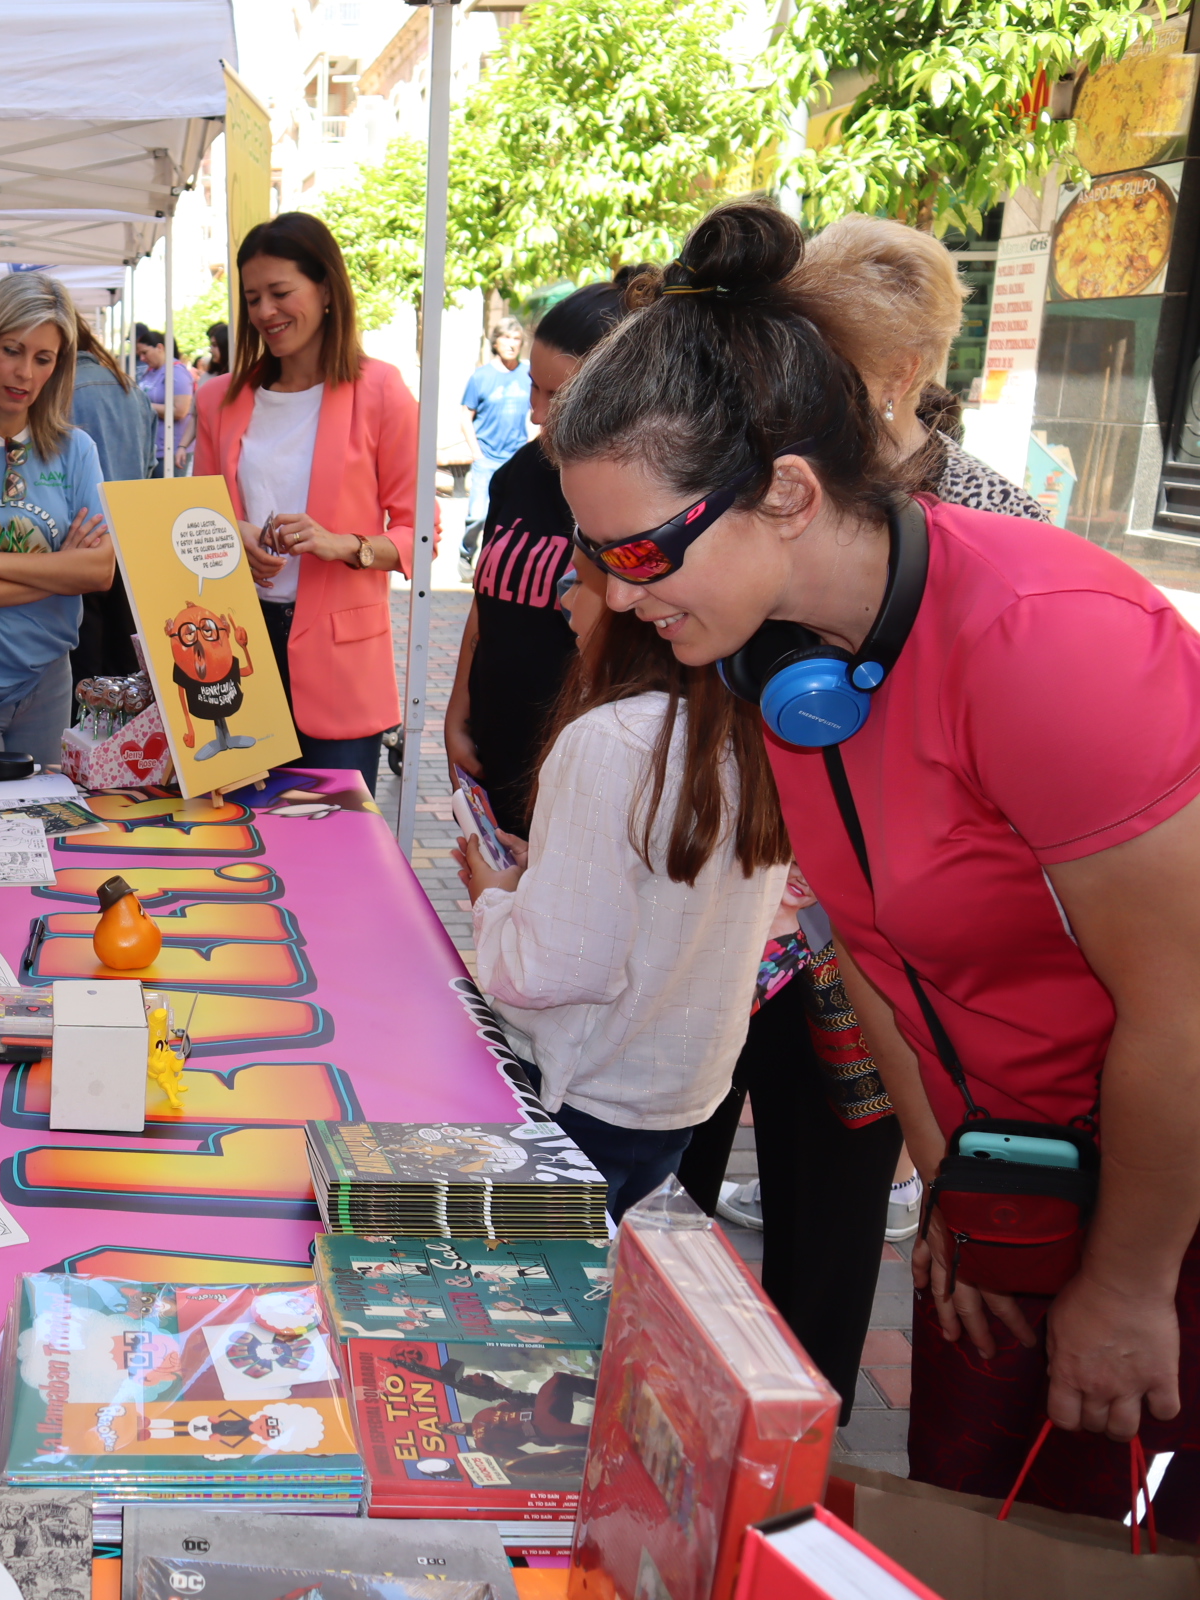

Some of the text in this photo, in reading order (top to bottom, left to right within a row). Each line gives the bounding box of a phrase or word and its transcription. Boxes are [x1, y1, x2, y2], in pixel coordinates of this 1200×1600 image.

[1077, 177, 1157, 204] ASADO DE PULPO
[1030, 238, 1049, 251] Gris
[10, 501, 59, 538] LECTURA
[473, 518, 576, 611] ÁLID
[798, 709, 820, 722] ENERGY
[123, 750, 143, 760] Jelly
[138, 759, 157, 769] Rose
[332, 1266, 371, 1312] TIEMPOS
[368, 1283, 390, 1295] de
[425, 1243, 498, 1336] HARINA & Sal
[42, 1292, 72, 1357] Trinidad
[358, 1352, 380, 1404] SOLIDARIO!
[36, 1360, 71, 1434] llamaban
[365, 1406, 385, 1444] ESPECIAL
[379, 1375, 419, 1461] EL TÍO
[410, 1382, 447, 1452] SAÍN
[183, 1539, 210, 1552] DC
[173, 1573, 203, 1590] DC
